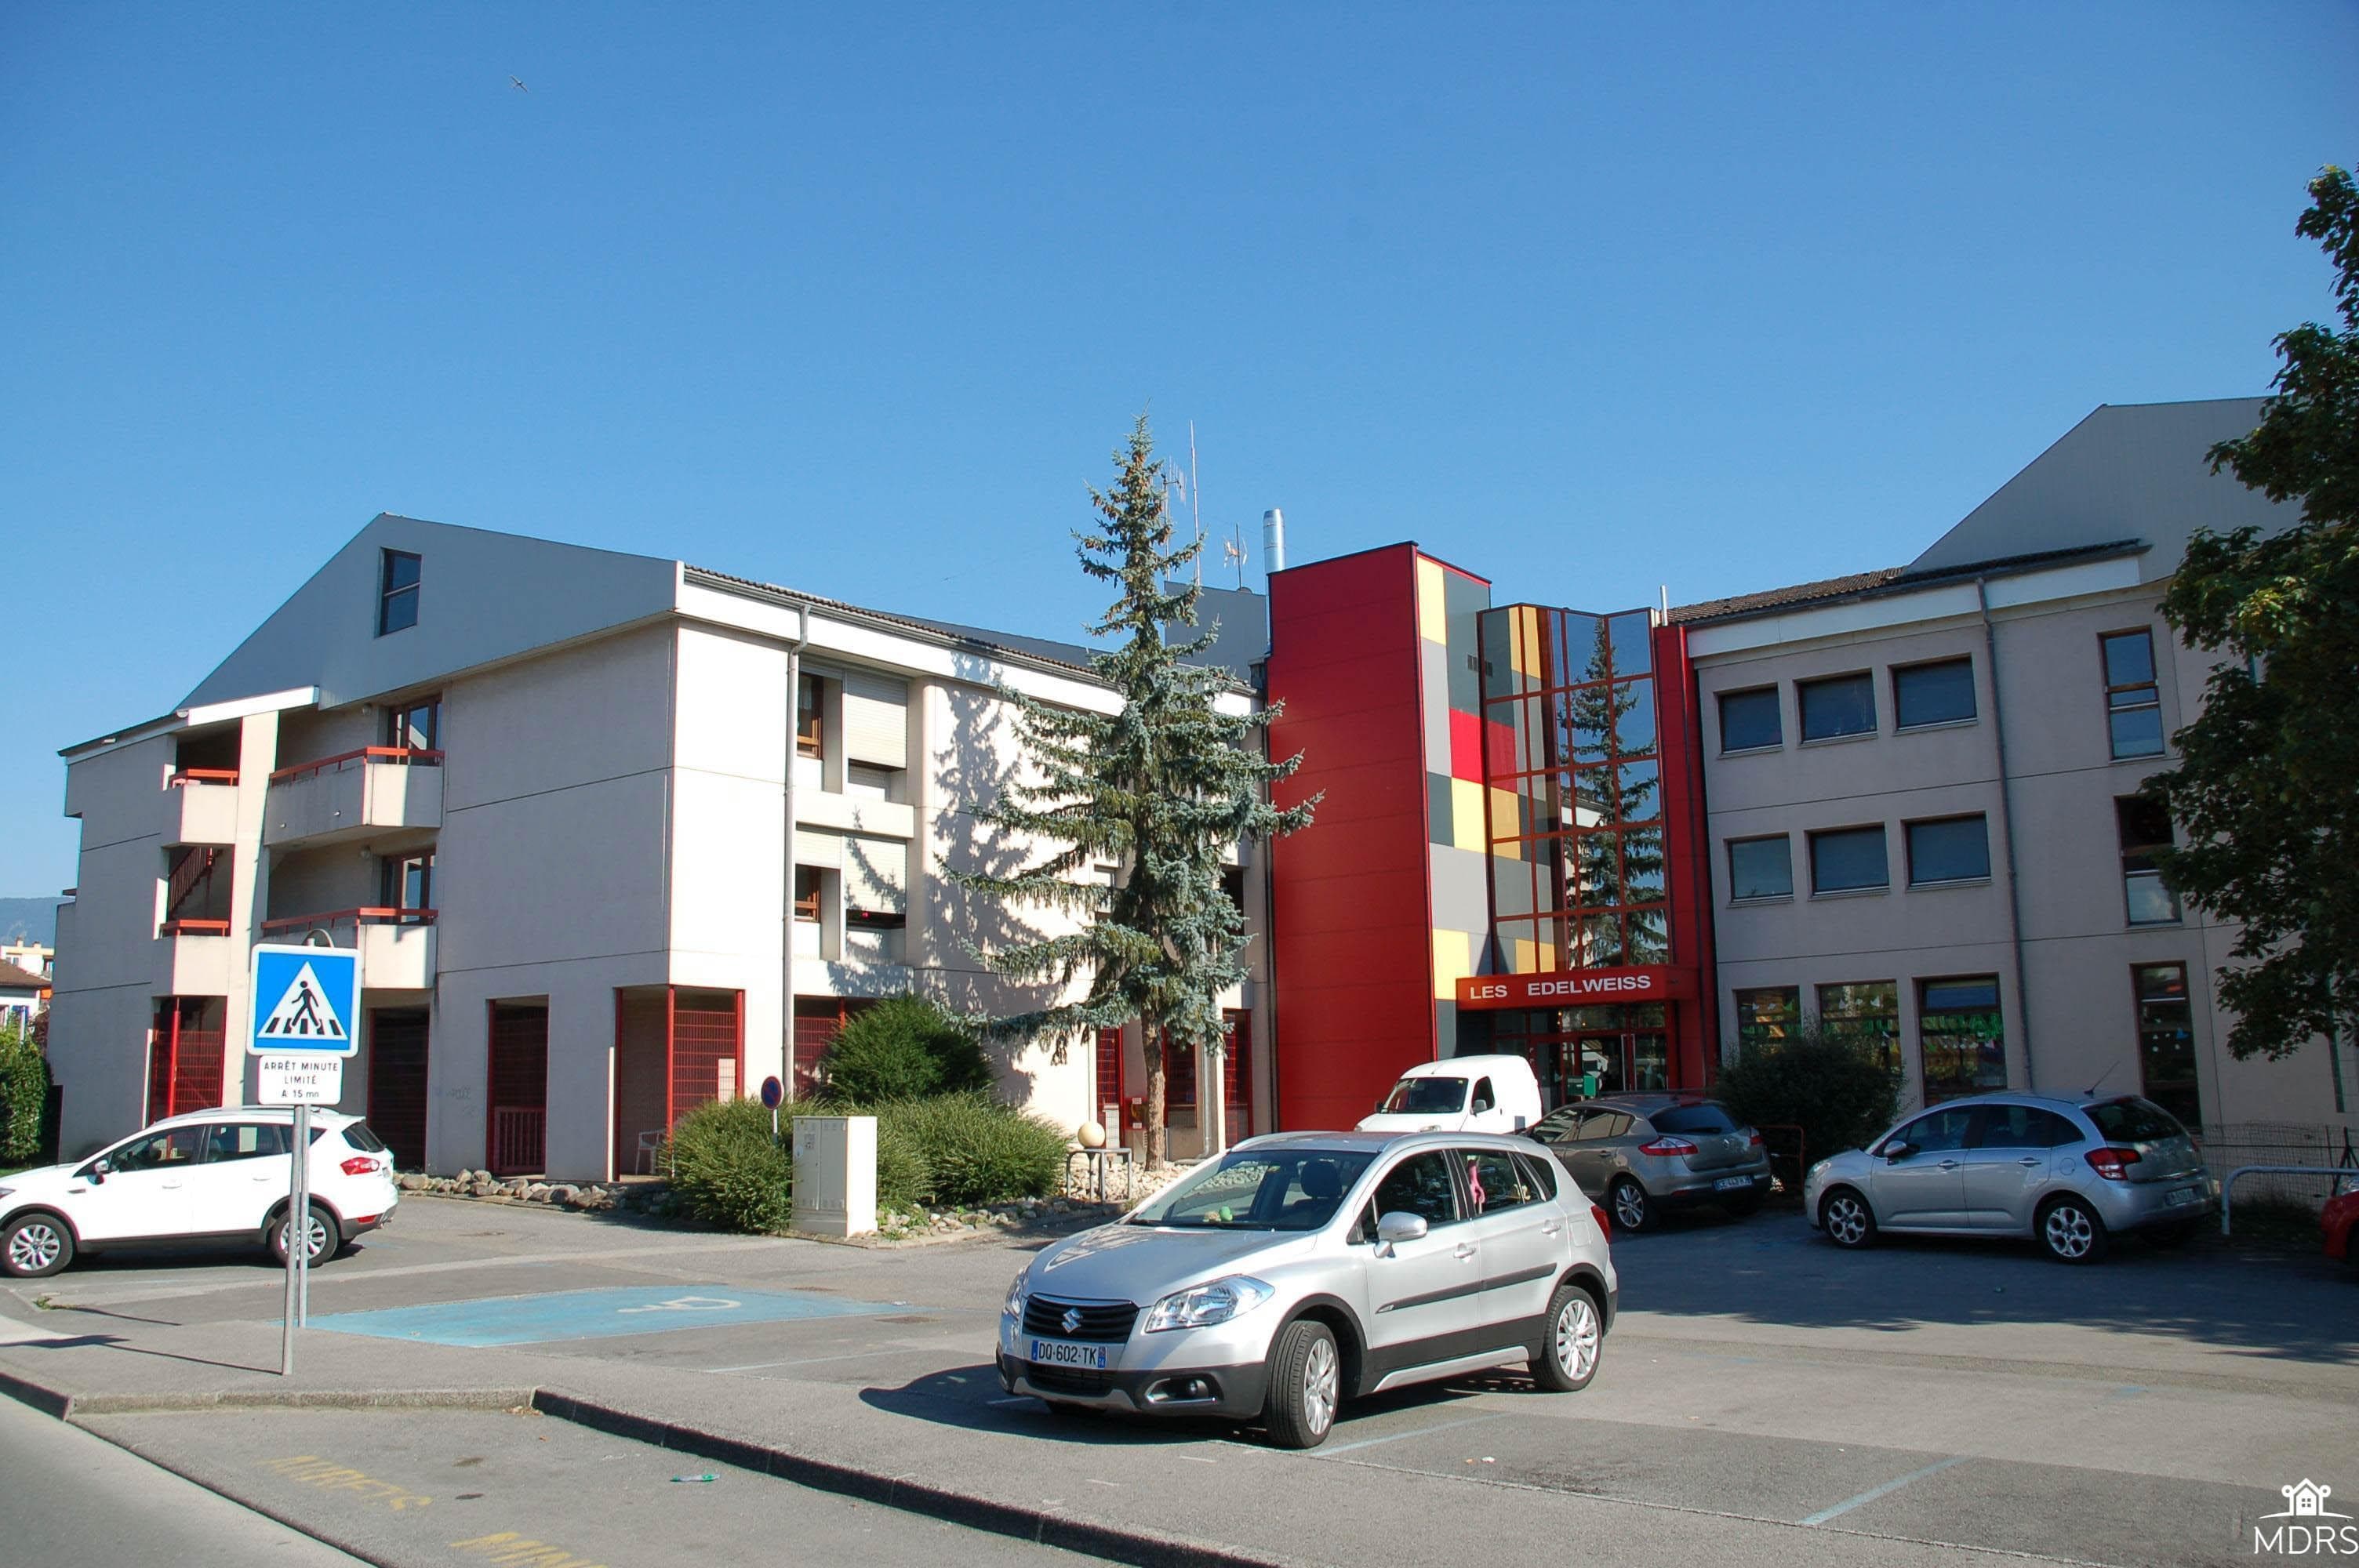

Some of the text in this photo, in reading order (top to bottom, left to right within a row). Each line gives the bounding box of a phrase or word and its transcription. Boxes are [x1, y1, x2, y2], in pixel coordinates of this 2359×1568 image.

[1470, 975, 1651, 1000] LES EDELWEISS
[264, 1060, 339, 1072] ARRÊT MINUTE
[293, 1089, 303, 1098] 15
